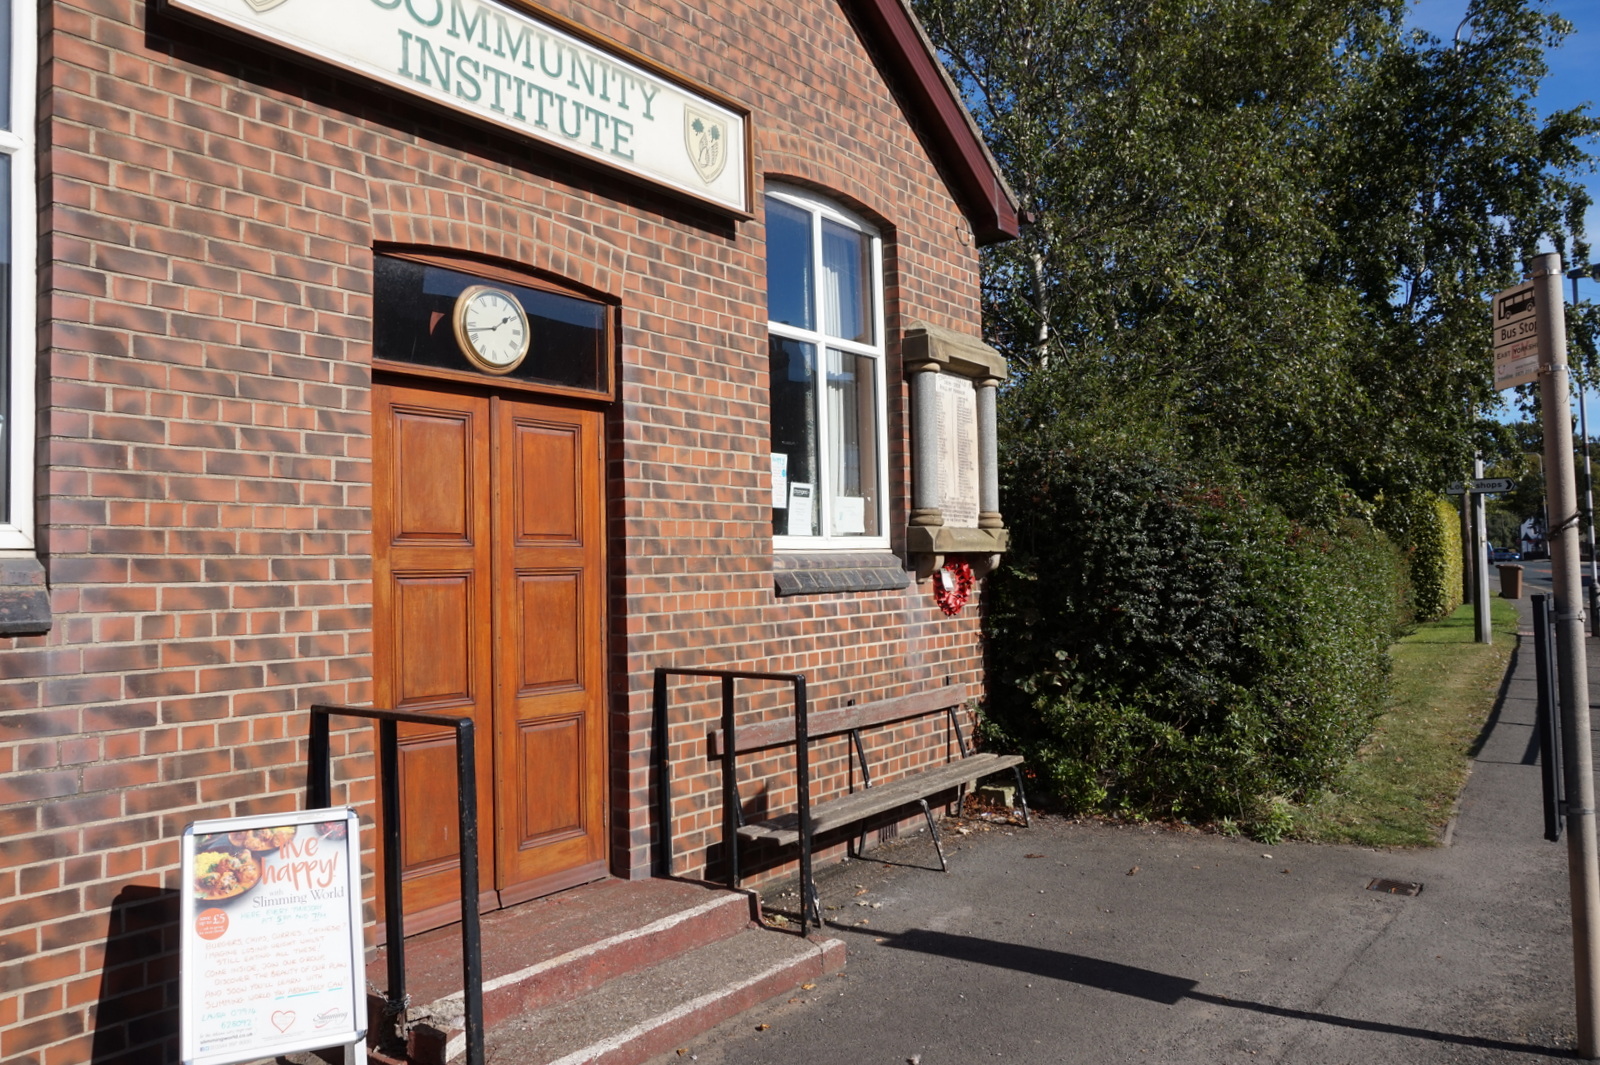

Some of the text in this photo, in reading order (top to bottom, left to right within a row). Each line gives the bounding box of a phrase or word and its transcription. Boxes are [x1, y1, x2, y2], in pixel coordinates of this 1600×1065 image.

[369, 0, 661, 121] OMMUNITY
[398, 28, 634, 161] INSTITUTE
[1501, 328, 1516, 340] Bus
[280, 834, 318, 859] live
[262, 851, 338, 891] happy!
[252, 886, 344, 908] Slimming World
[213, 914, 226, 924] £5
